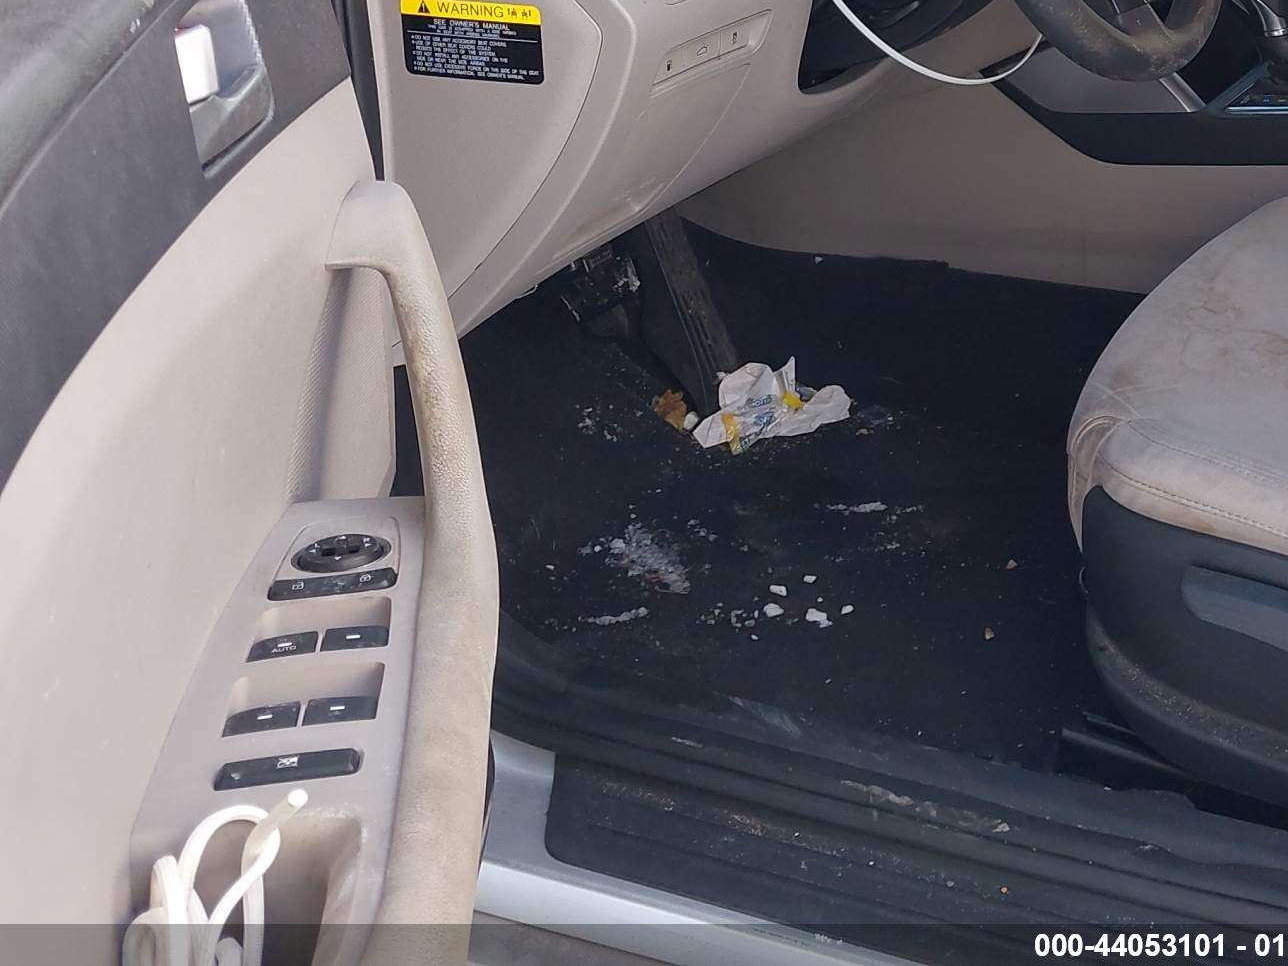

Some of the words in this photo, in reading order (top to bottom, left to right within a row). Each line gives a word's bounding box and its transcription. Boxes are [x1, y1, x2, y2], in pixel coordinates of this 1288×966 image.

[437, 1, 504, 18] WARNING
[450, 20, 479, 28] OWNER'S
[483, 22, 510, 31] MANUAL
